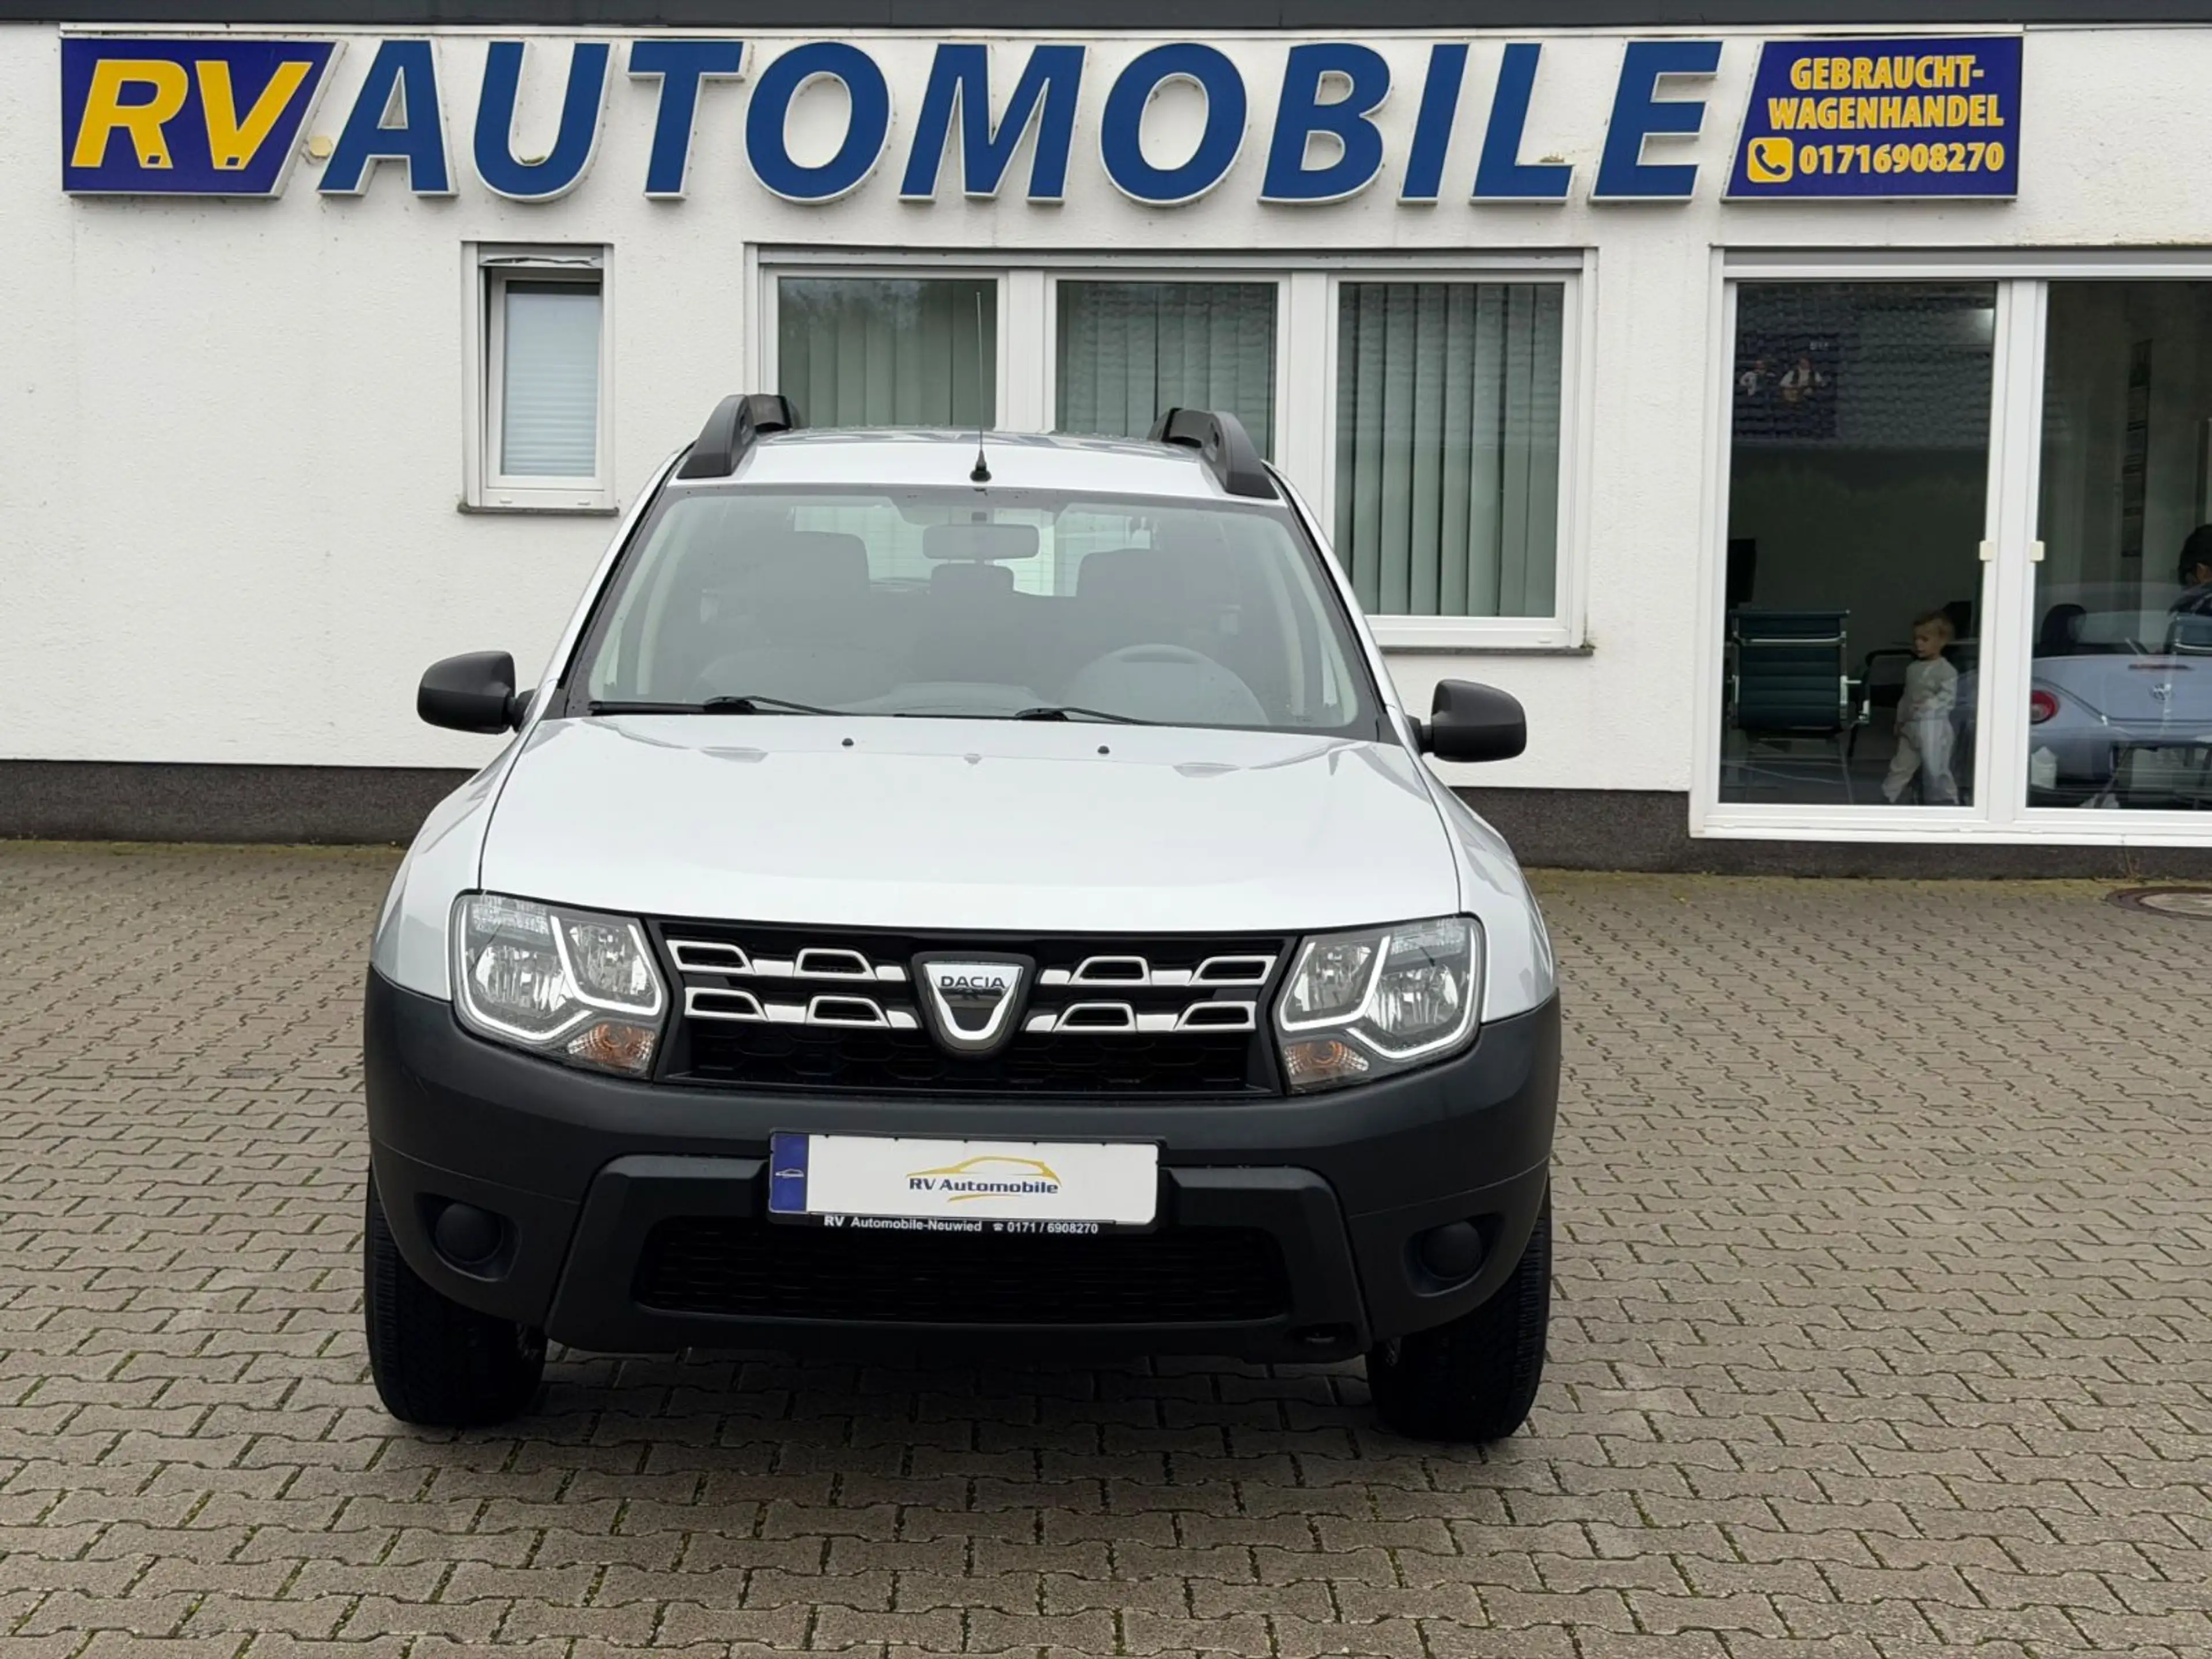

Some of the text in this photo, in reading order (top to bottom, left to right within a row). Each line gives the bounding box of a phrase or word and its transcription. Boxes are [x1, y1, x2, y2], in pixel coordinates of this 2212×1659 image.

[1790, 55, 1985, 90] GEBRAUCHT-
[71, 39, 1723, 205] RV AUTOMOBILE
[1767, 94, 2005, 130] WAGENHANDEL
[1798, 142, 2005, 175] 01716908270
[940, 975, 1006, 988] DACIA
[909, 1177, 1059, 1194] RV Automobile
[824, 1215, 845, 1227] RV
[850, 1216, 982, 1232] Automobile-Neuwied
[1007, 1221, 1036, 1233] 0171
[1047, 1223, 1099, 1234] 6908270
